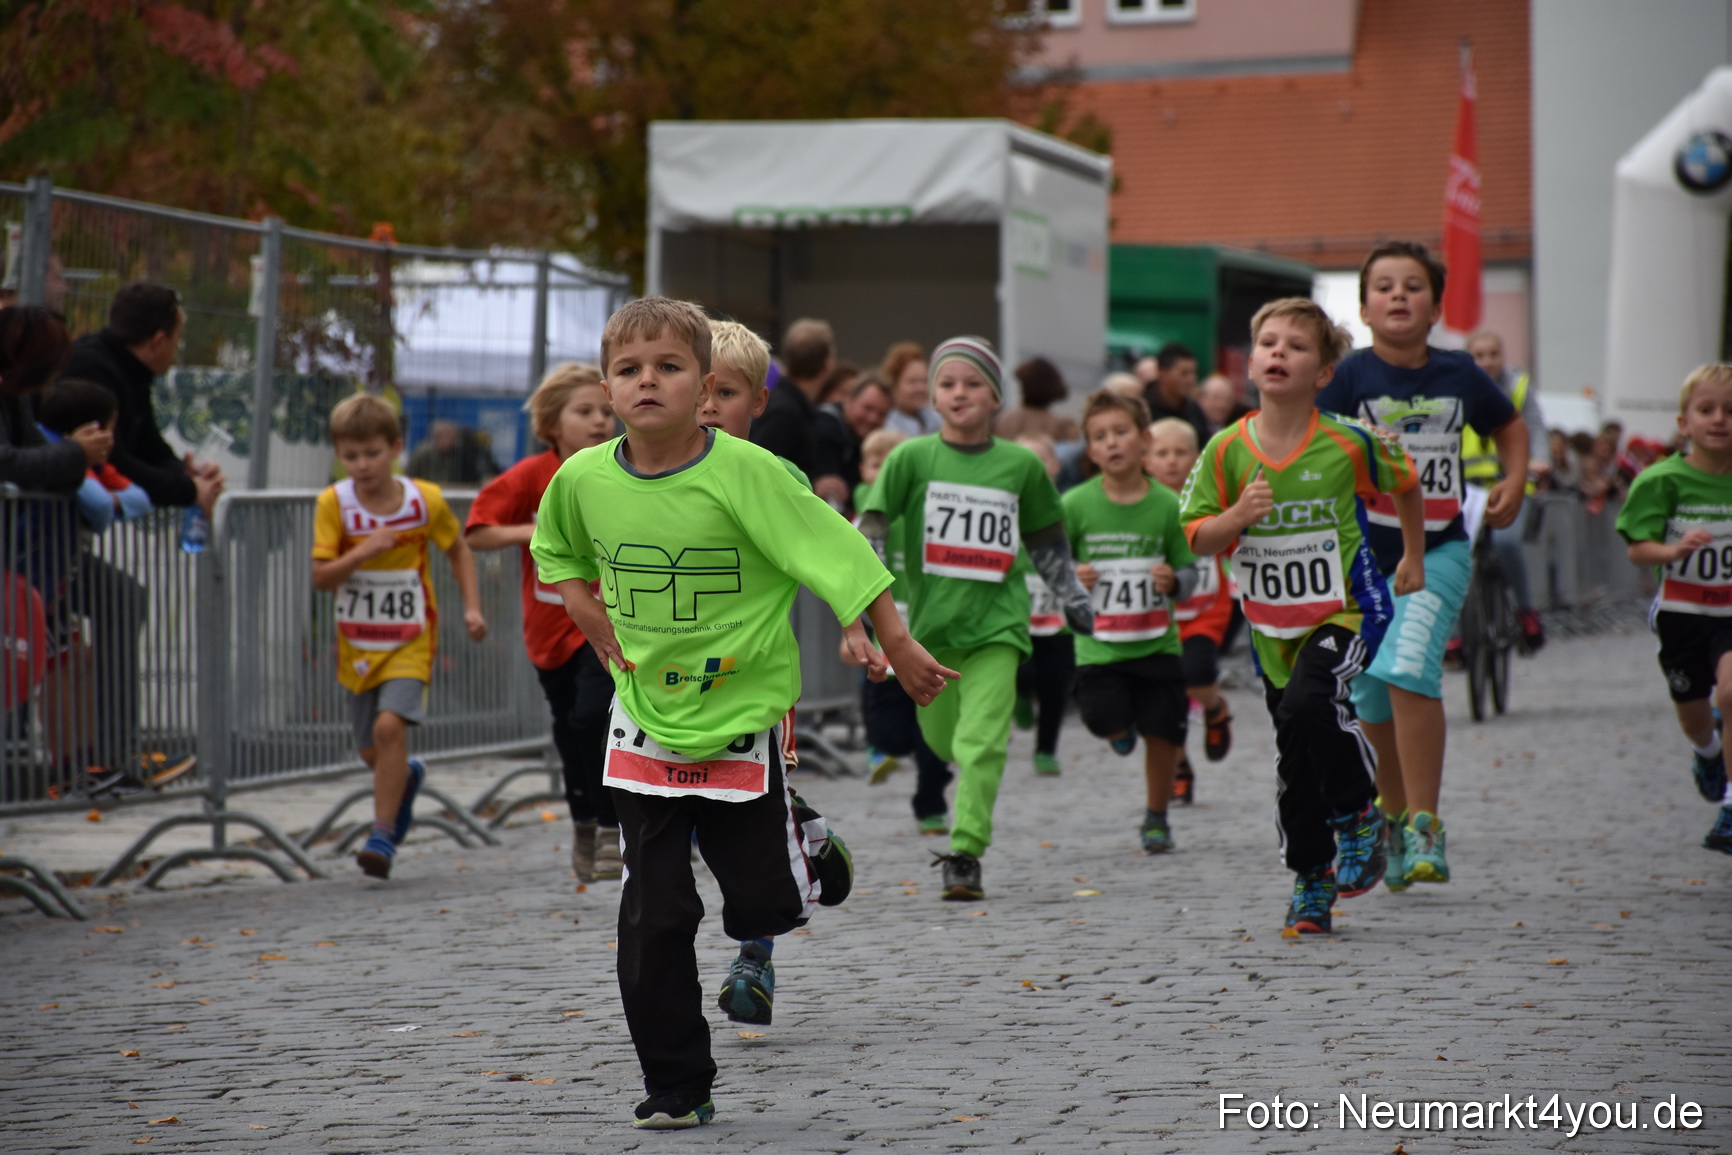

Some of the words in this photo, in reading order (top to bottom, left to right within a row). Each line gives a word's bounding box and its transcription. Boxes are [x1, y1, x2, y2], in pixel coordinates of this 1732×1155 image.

[1413, 457, 1452, 494] 43
[937, 506, 1012, 548] 7108
[943, 550, 1003, 568] Jonathan
[1263, 544, 1319, 558] Neumarkt
[1240, 557, 1332, 600] 7600
[346, 589, 415, 620] 7148
[622, 620, 712, 635] Automatisierungstechnik
[714, 620, 743, 631] GmbH
[665, 669, 741, 686] Bretschneider
[665, 766, 710, 784] Toni
